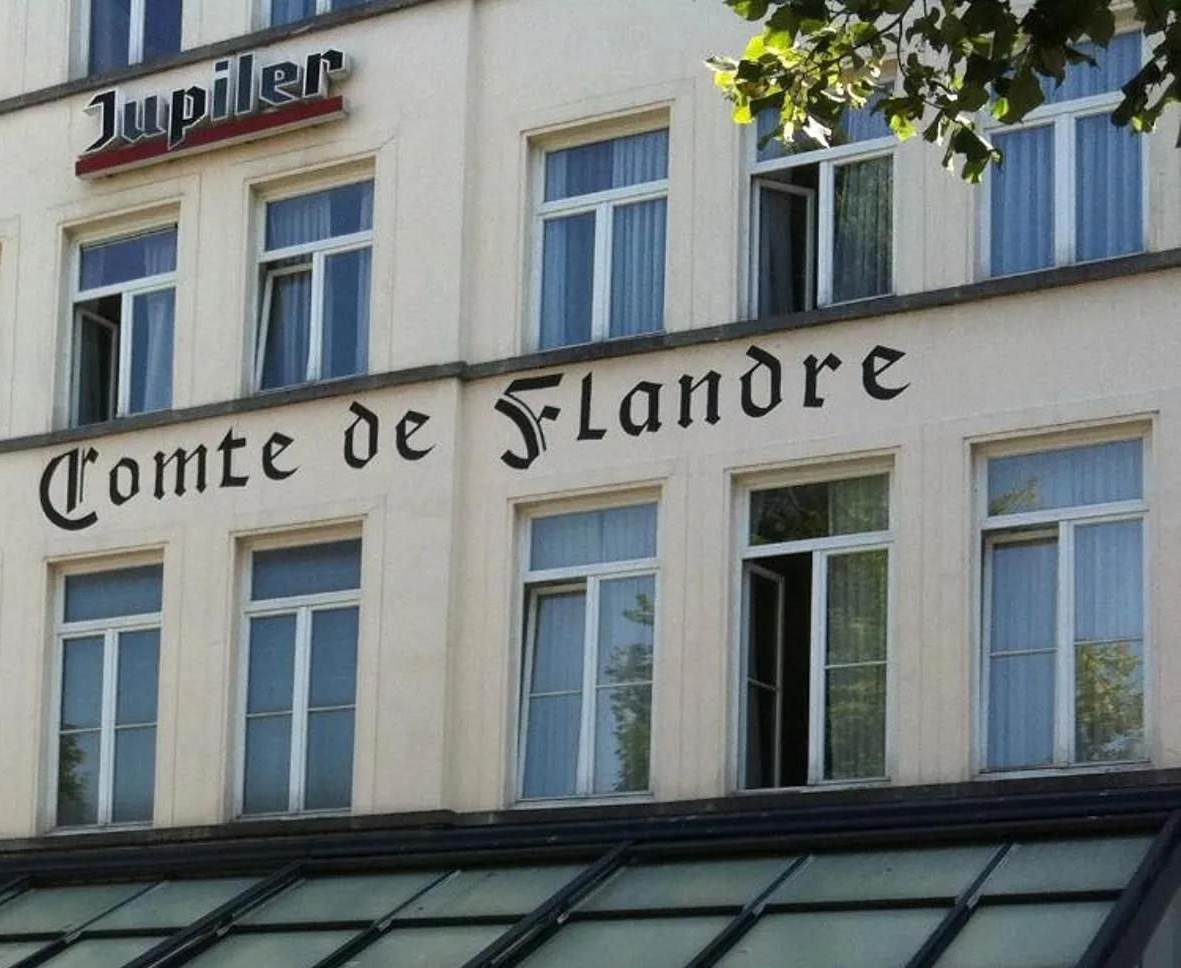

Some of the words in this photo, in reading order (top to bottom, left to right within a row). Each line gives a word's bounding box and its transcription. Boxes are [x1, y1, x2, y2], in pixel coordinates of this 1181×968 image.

[82, 49, 351, 152] Jupiler
[40, 427, 300, 531] Comte
[343, 401, 435, 469] de
[495, 345, 910, 469] Flandre
